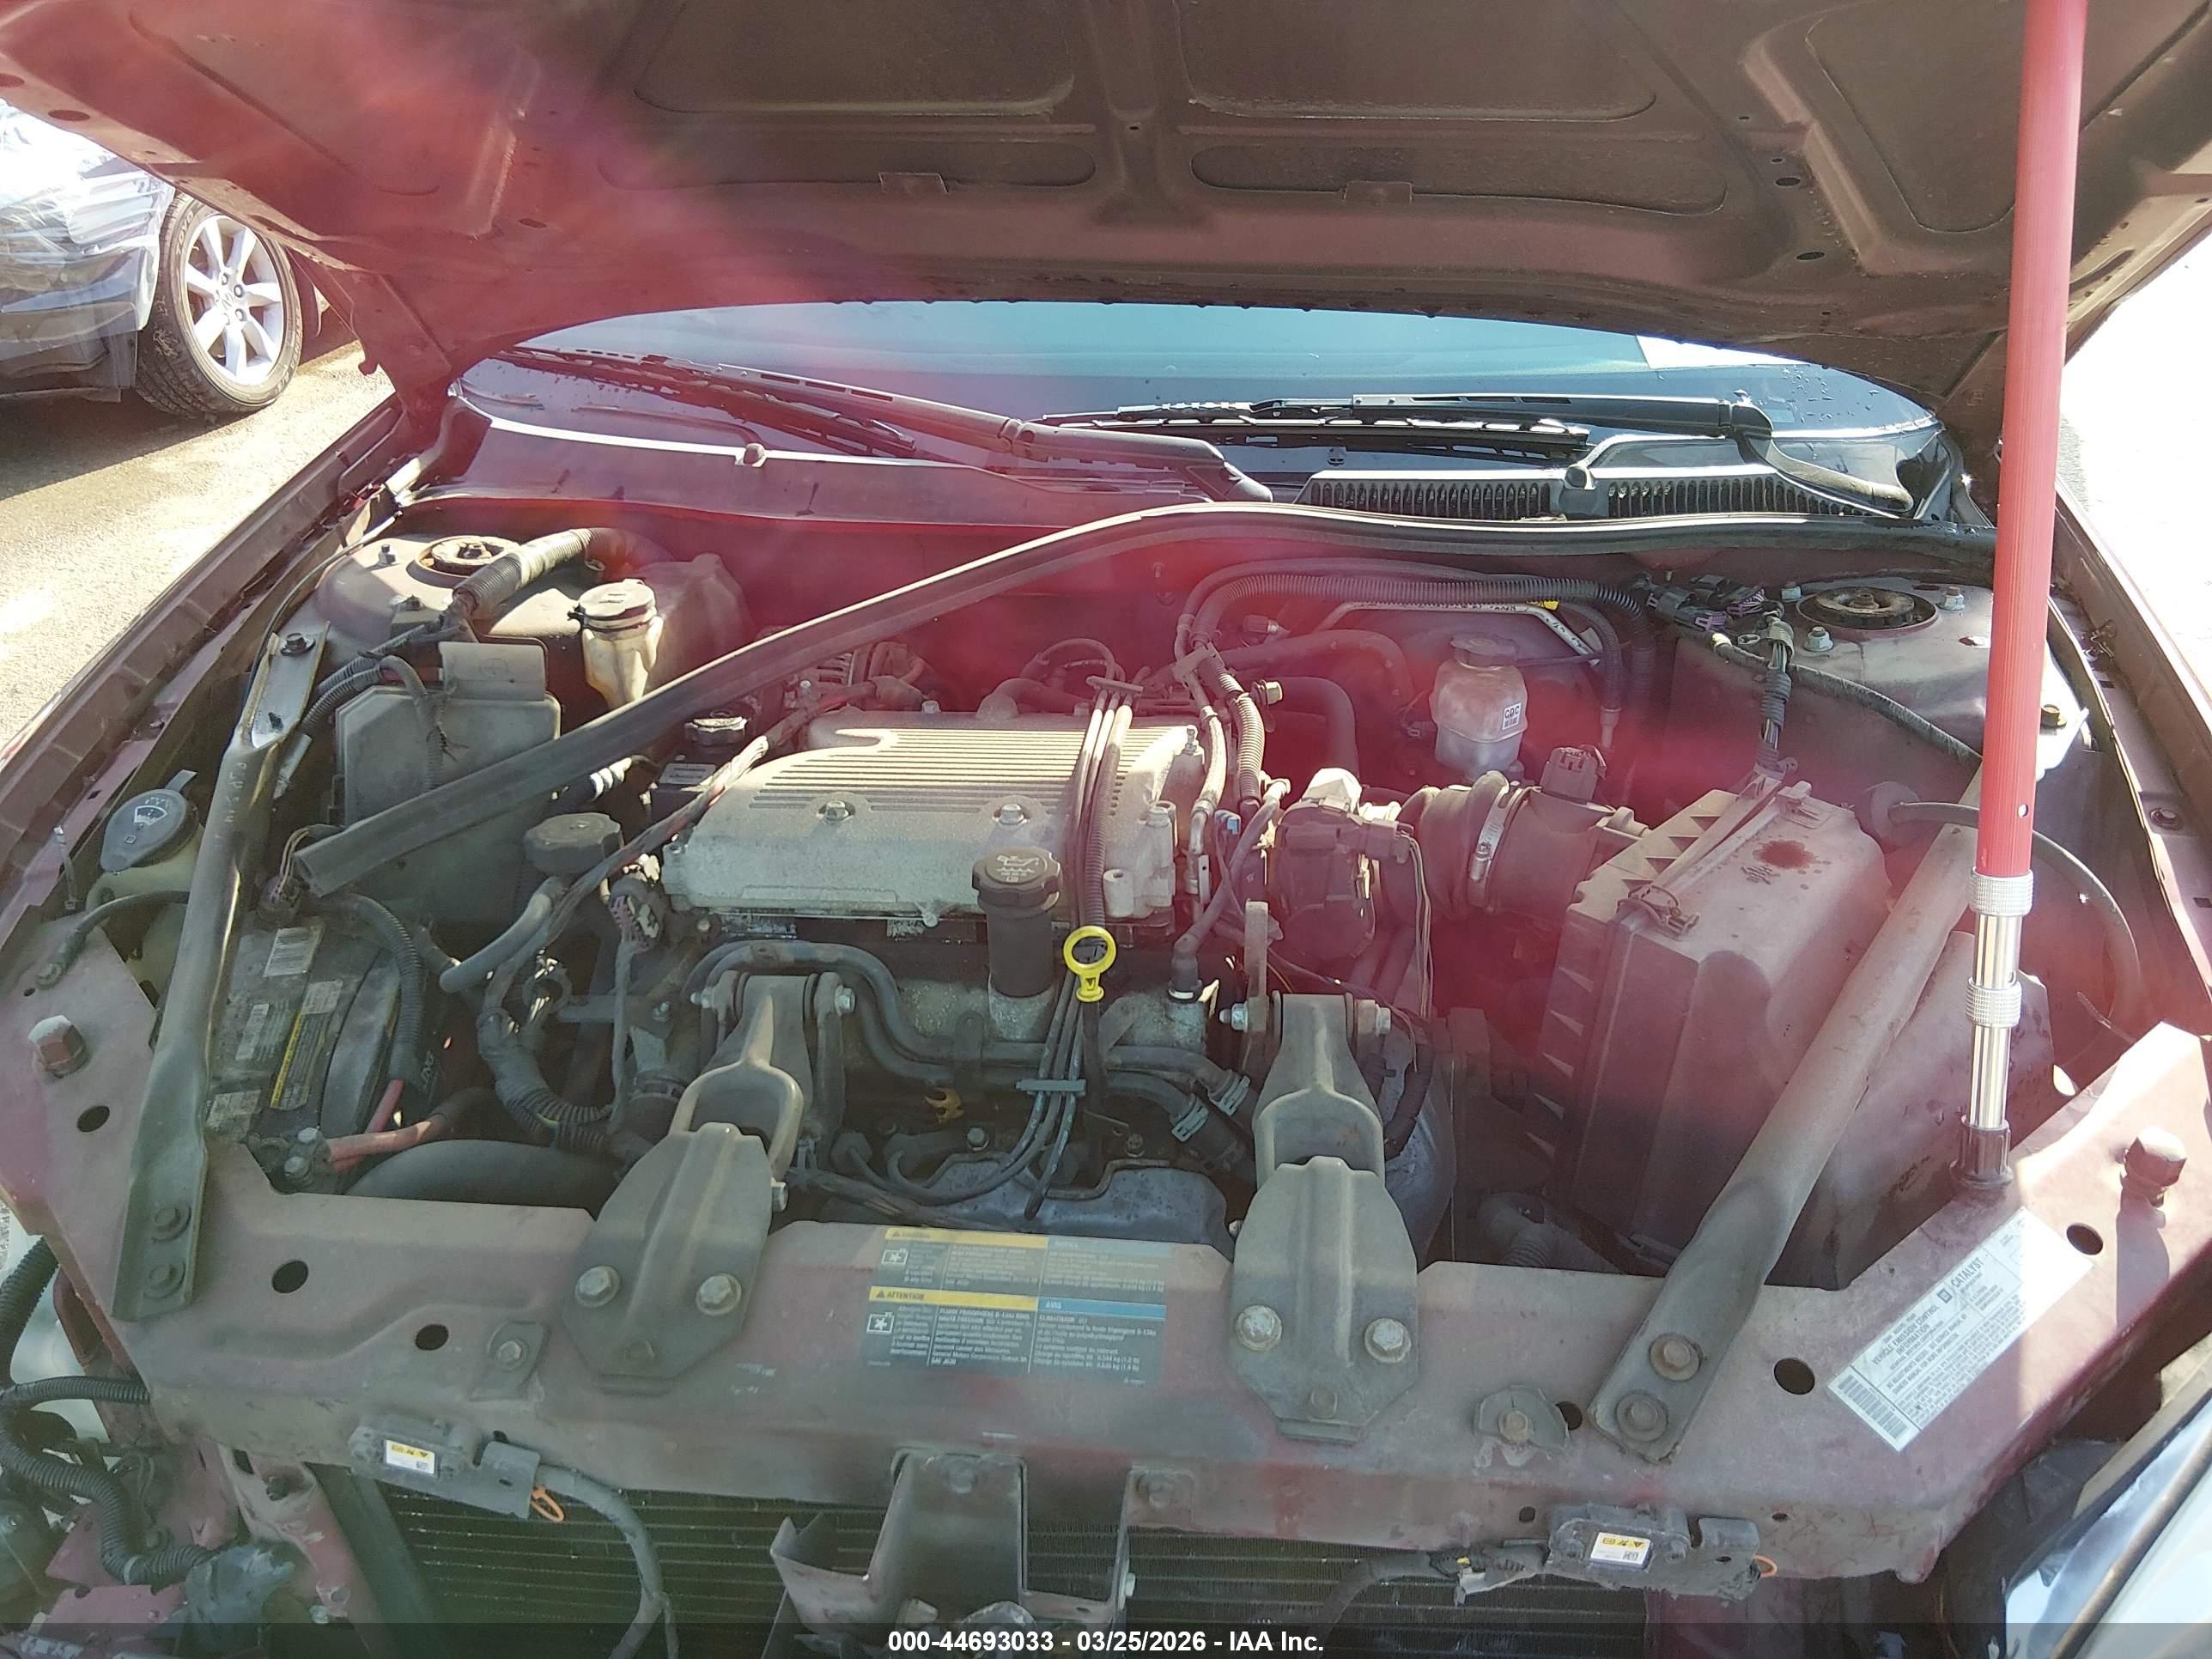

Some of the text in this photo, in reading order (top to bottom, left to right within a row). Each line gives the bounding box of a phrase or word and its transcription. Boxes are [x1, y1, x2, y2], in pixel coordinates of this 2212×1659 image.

[176, 210, 193, 255] TOYO
[1504, 706, 1520, 719] CDC
[1951, 1257, 1984, 1288] CATALYST
[887, 1291, 925, 1300] ATTENTION
[1045, 1300, 1062, 1310] AVIS
[1872, 1344, 1893, 1364] VEHICLE
[1893, 1322, 1917, 1346] EMISSION
[1915, 1304, 1938, 1325] CONTROL
[1895, 1322, 1929, 1354] INFORMATION
